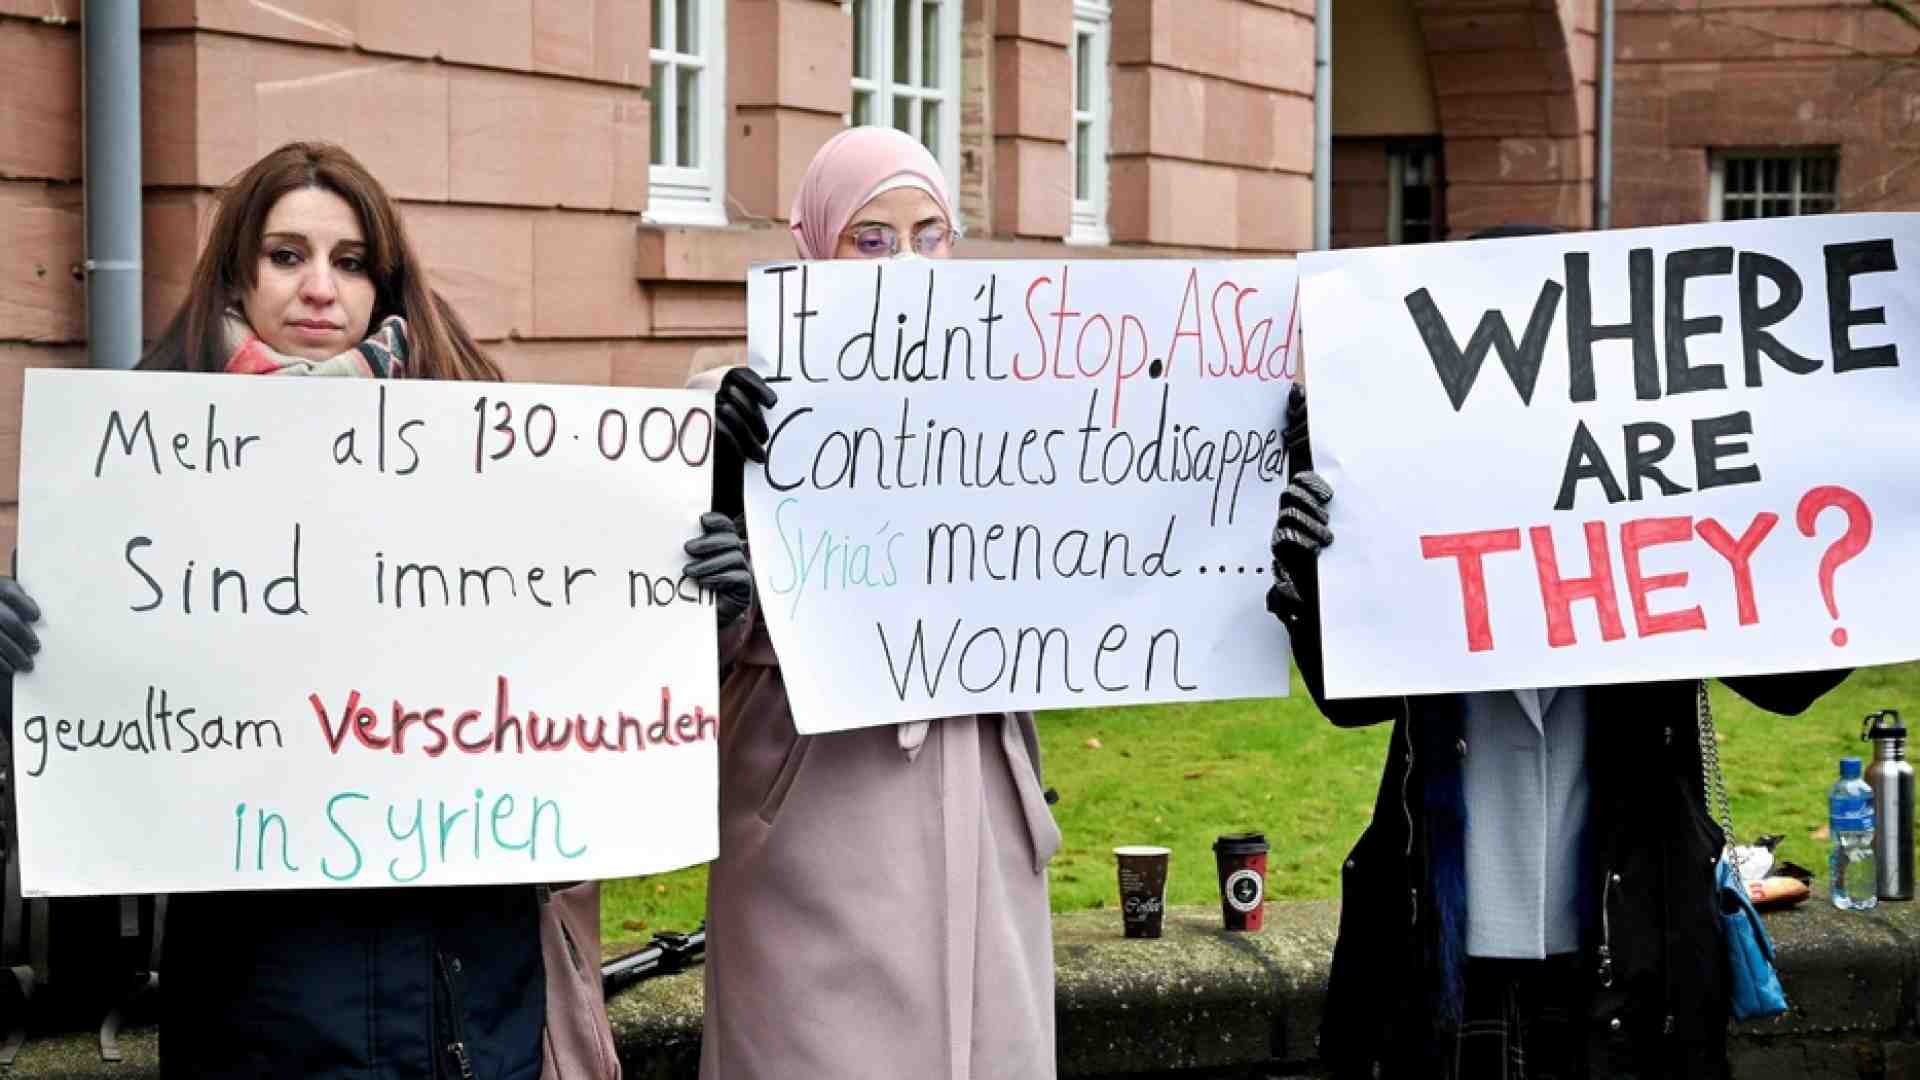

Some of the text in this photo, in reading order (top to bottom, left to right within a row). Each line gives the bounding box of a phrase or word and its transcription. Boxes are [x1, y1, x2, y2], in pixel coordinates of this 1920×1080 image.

[763, 264, 828, 384] It
[1164, 267, 1300, 381] Assad
[1404, 238, 1899, 412] WHERE
[95, 401, 261, 477] Mehr
[332, 385, 425, 475] als
[763, 397, 1066, 491] Continues
[1553, 411, 1761, 510] ARE
[125, 523, 308, 616] Sind
[375, 551, 596, 608] immer
[768, 497, 905, 621] Syria's
[925, 521, 1042, 584] men
[1420, 484, 1873, 653] THEY?
[876, 617, 1198, 701] Women
[23, 676, 719, 777] gewaltsam Verschwunden
[234, 787, 588, 883] in Syrien
